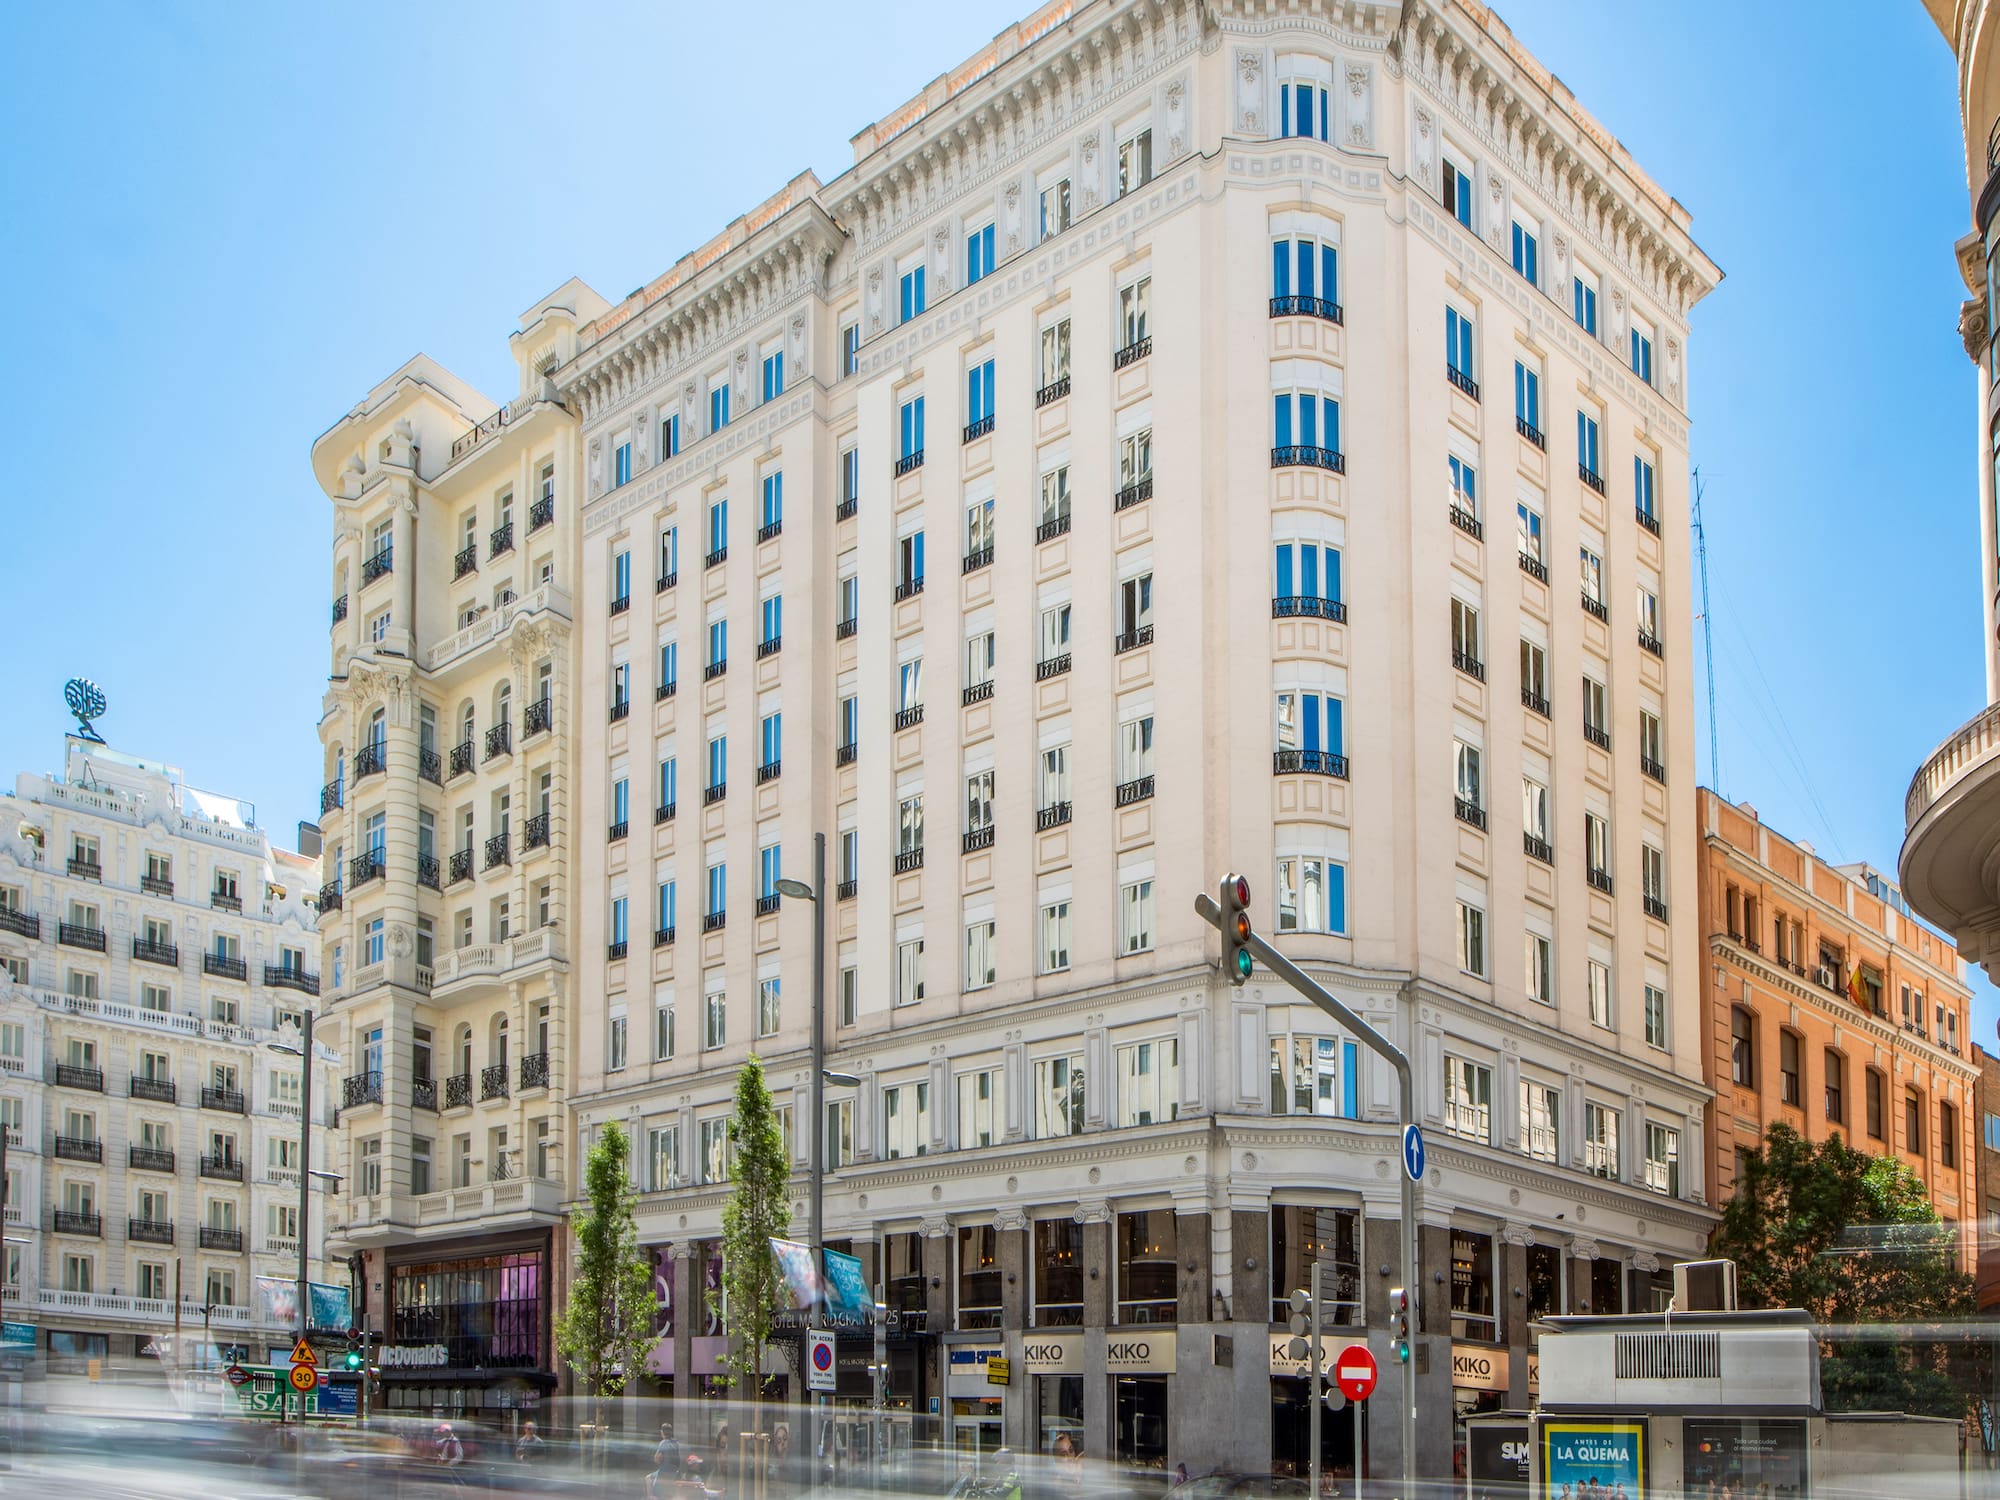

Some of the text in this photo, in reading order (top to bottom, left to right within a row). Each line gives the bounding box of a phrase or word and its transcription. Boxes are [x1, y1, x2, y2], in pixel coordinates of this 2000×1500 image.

[799, 1312, 836, 1328] MARID
[886, 1310, 898, 1325] 25
[377, 1344, 449, 1366] McDonald's
[1024, 1345, 1063, 1360] KIKO
[1108, 1343, 1150, 1359] KIKO
[1453, 1356, 1491, 1375] KIKO
[295, 1372, 312, 1383] 30
[1557, 1447, 1630, 1462] LA QUEMA
